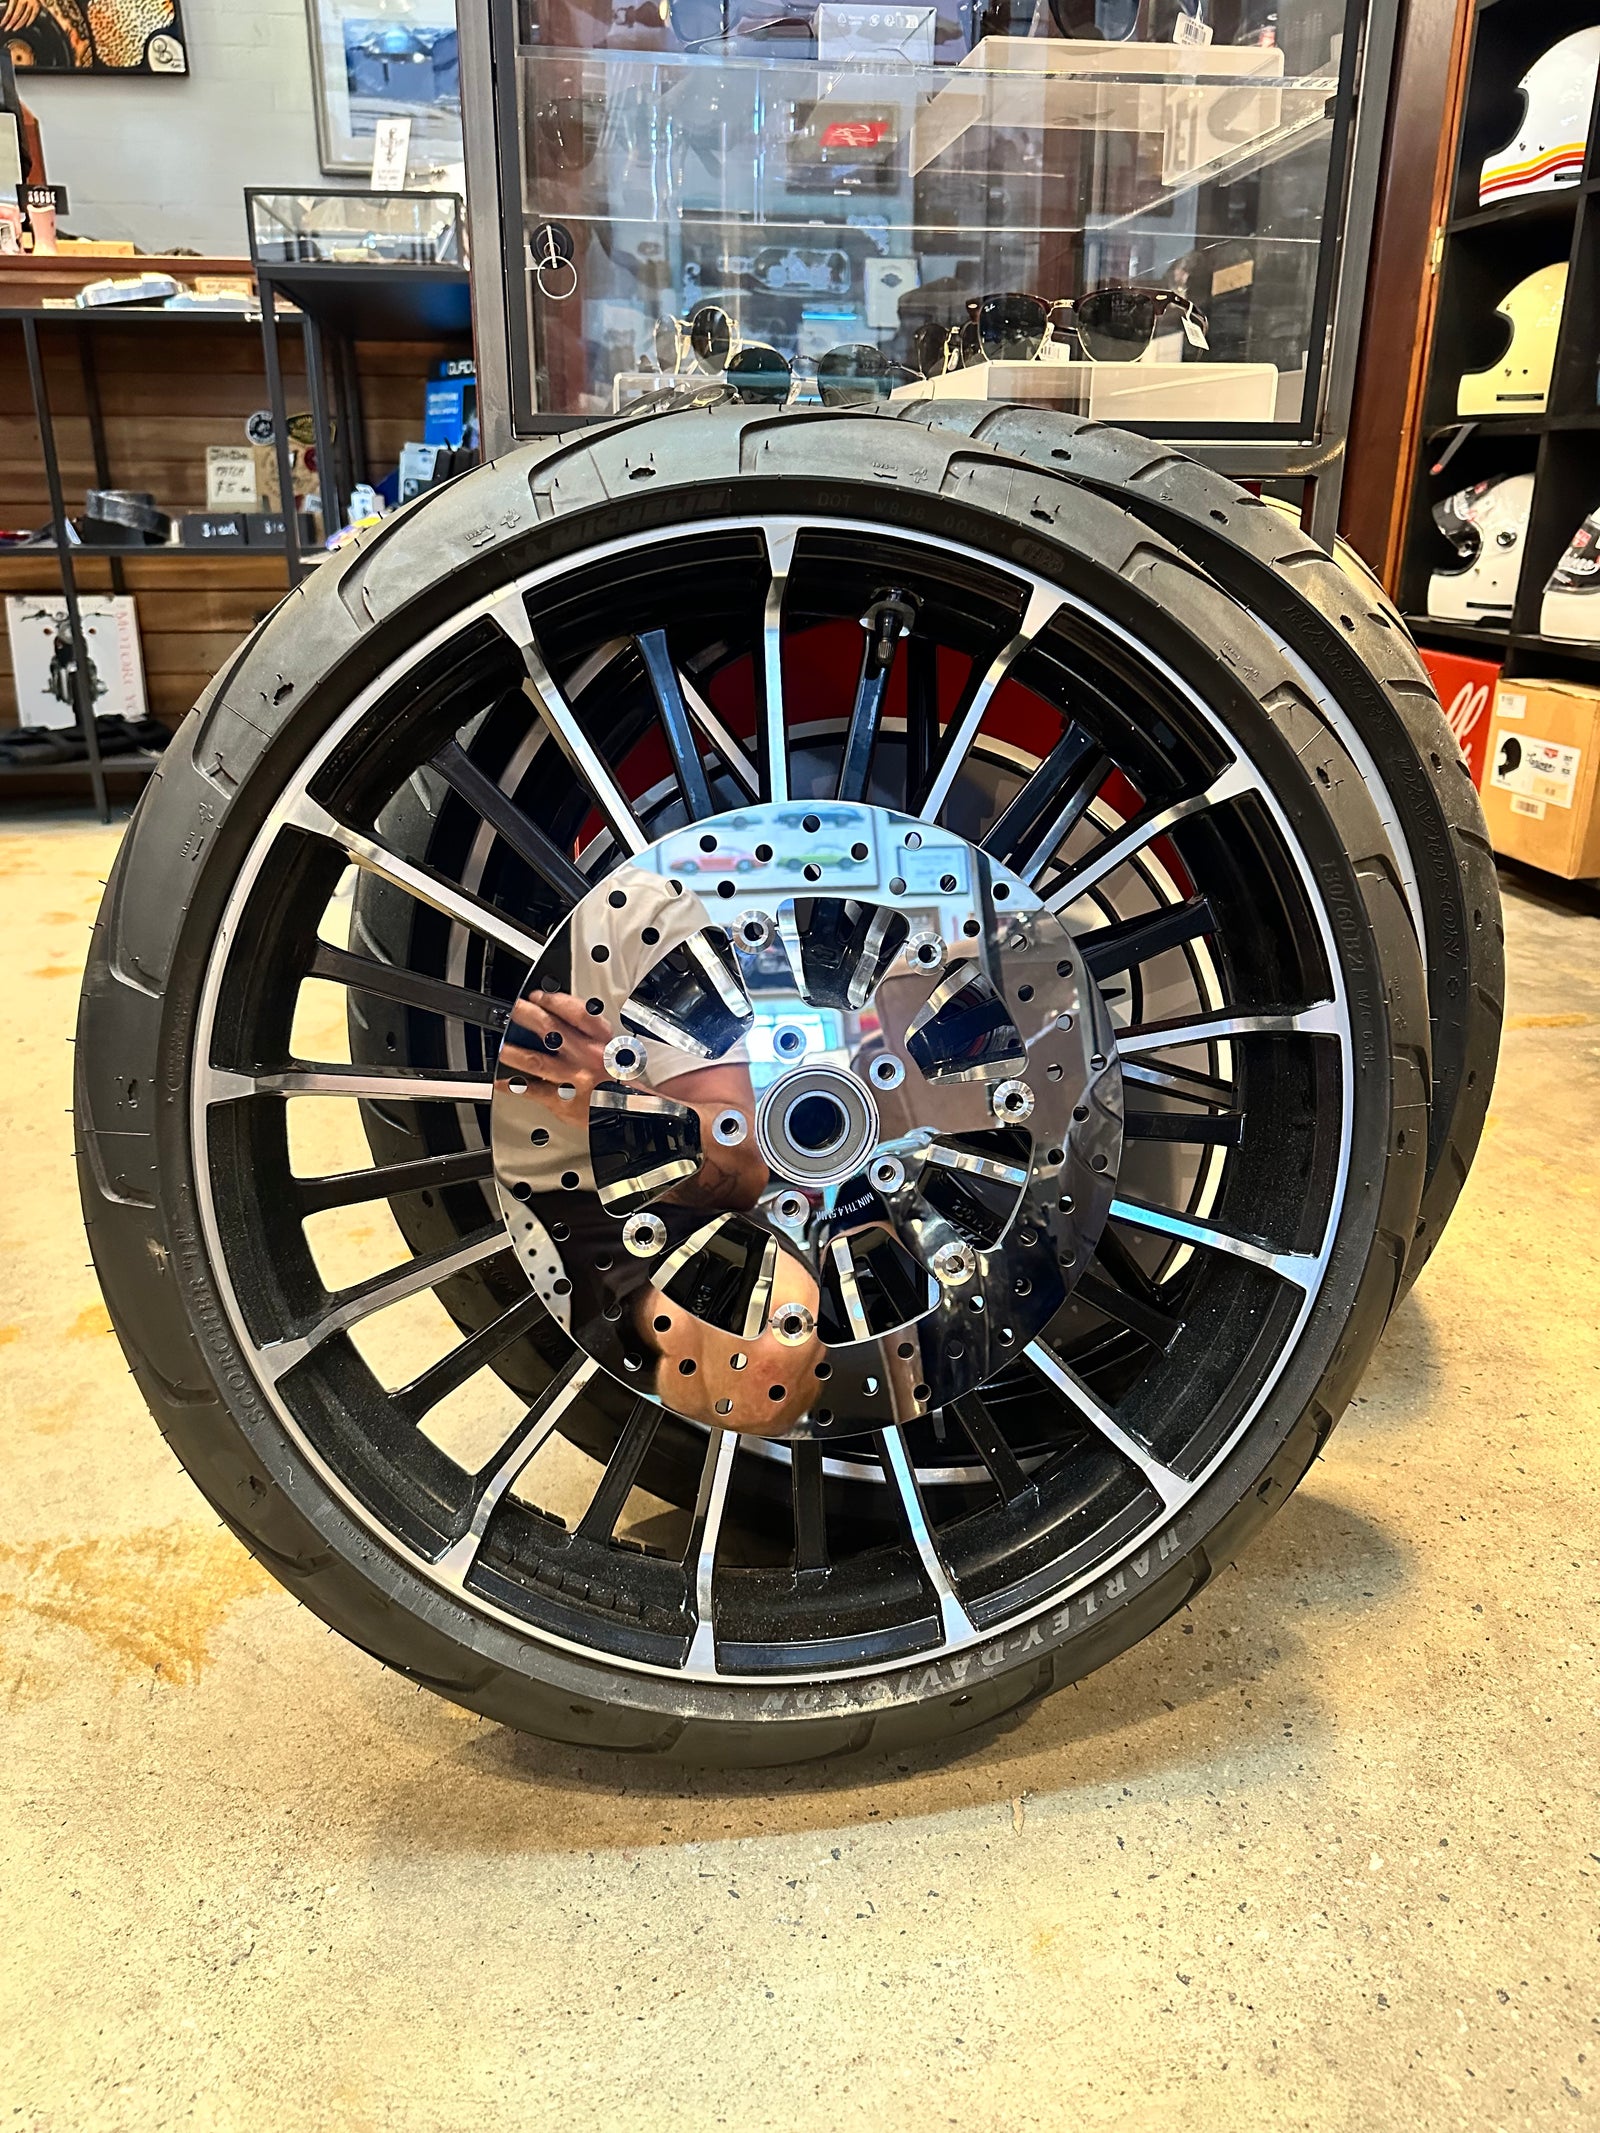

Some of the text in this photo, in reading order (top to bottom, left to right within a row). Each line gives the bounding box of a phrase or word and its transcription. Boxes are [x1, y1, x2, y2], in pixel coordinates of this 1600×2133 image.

[545, 489, 729, 551] MICHELIN
[816, 491, 854, 509] DOT
[183, 1273, 270, 1428] SCORCHER
[760, 1527, 1188, 1713] HARLEY-DAVIDSON
